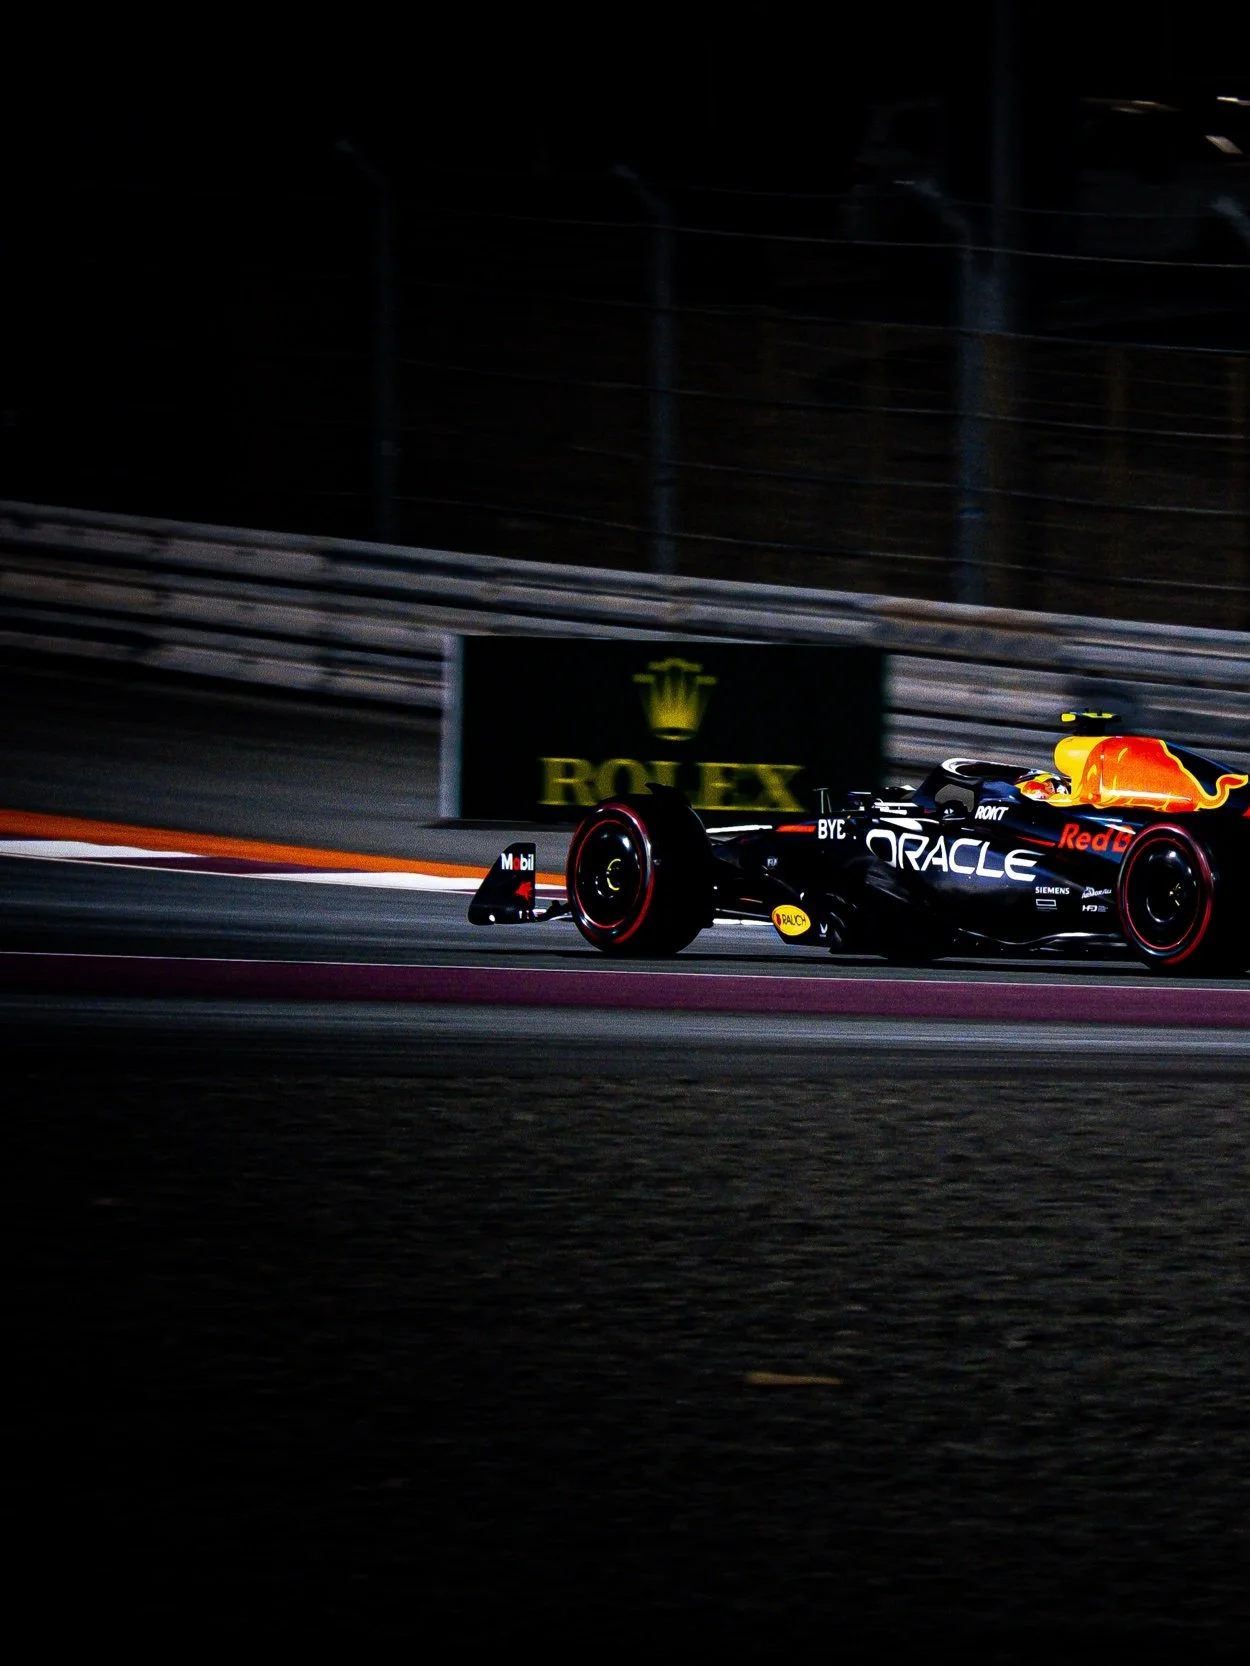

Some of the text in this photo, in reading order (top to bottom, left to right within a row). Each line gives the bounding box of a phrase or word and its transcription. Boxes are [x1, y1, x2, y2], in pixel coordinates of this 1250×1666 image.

[538, 757, 806, 812] ROLEX
[975, 806, 1009, 821] ROKT
[1058, 823, 1113, 852] Red
[500, 852, 534, 871] Mobil
[866, 829, 1047, 882] ORACLE
[1035, 886, 1070, 895] SIEMENS
[782, 913, 807, 926] RAUCH
